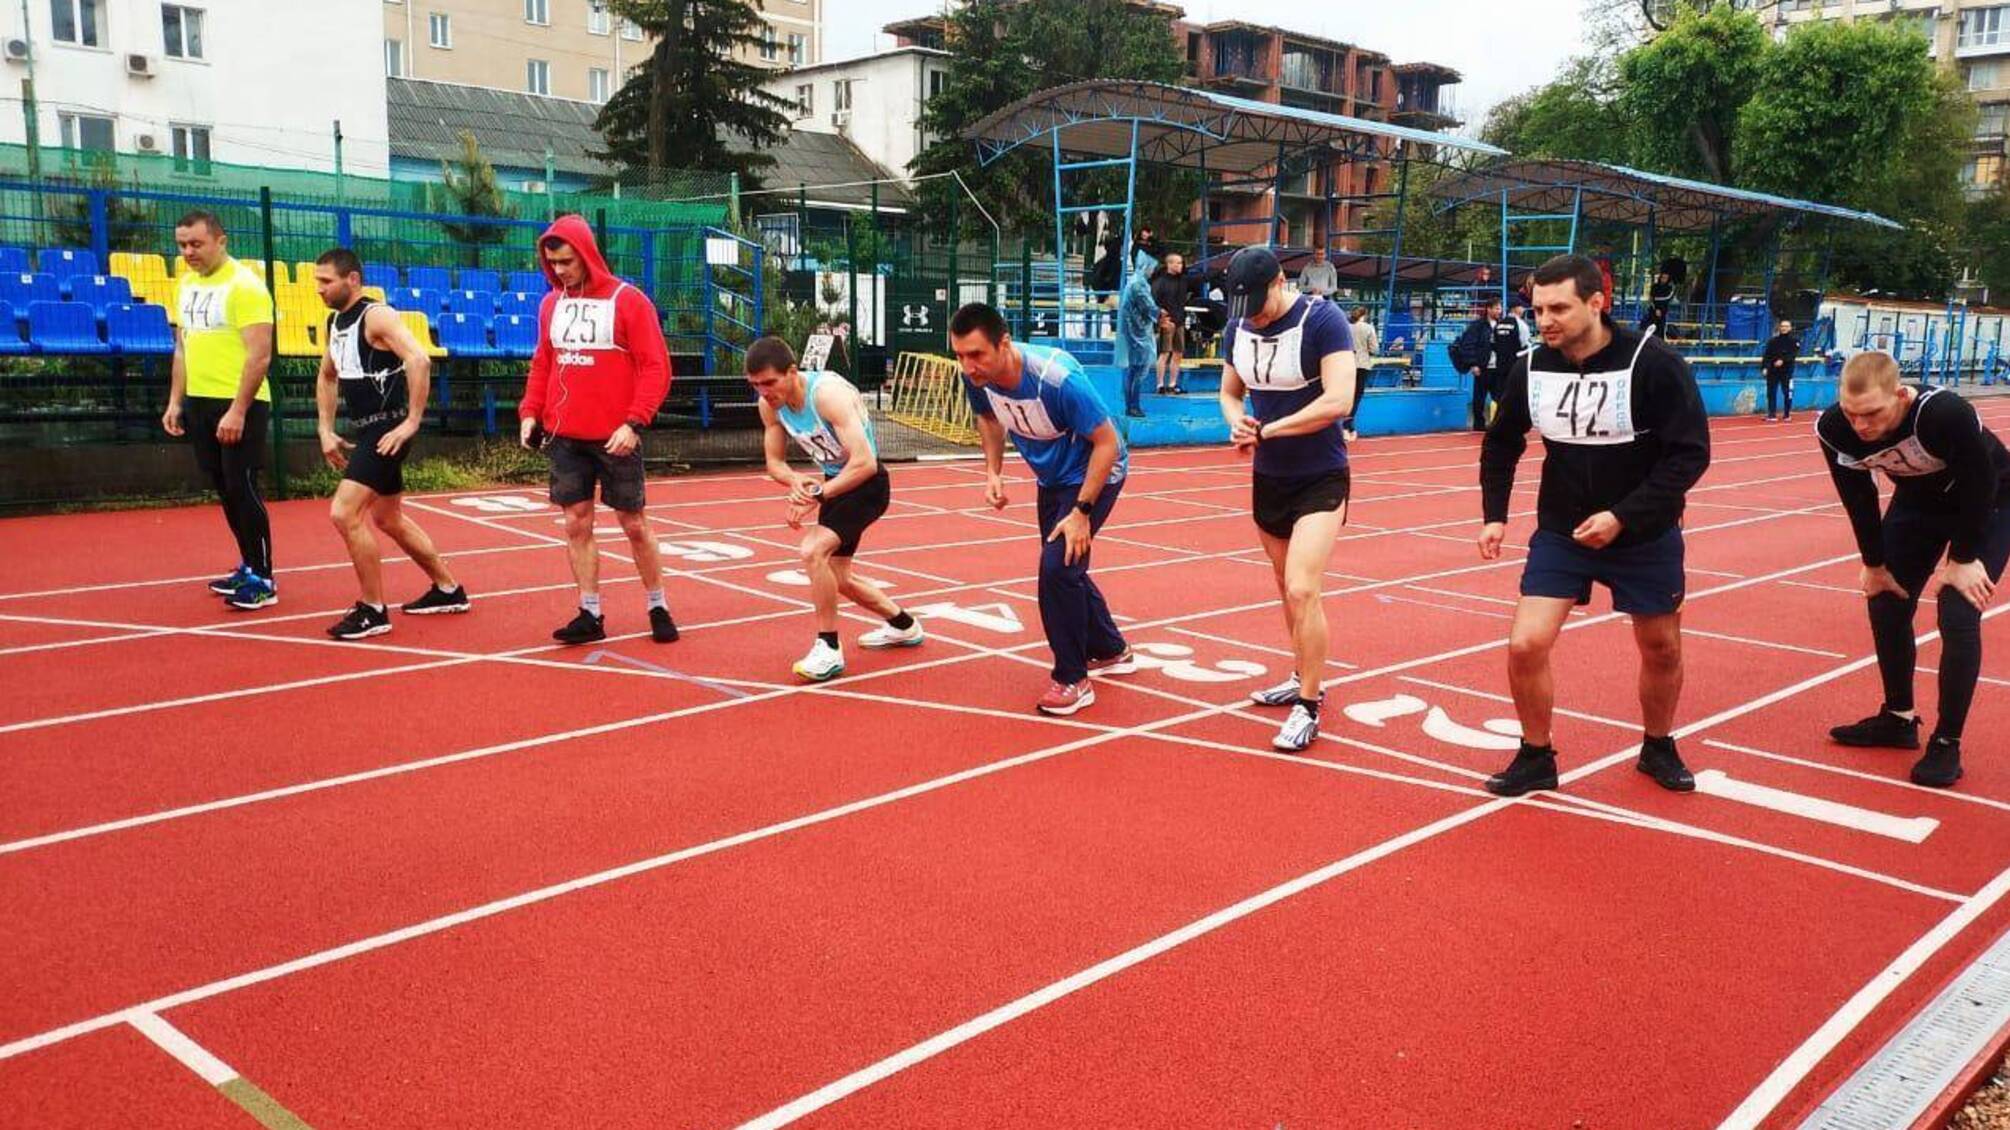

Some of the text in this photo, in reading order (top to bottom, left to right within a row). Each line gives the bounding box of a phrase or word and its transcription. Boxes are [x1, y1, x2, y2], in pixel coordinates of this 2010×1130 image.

[184, 291, 213, 327] 44
[562, 303, 598, 343] 25
[556, 353, 595, 366] adidas
[1251, 338, 1280, 384] 17
[1004, 402, 1036, 436] 11
[1556, 381, 1609, 436] 42
[905, 601, 1025, 633] 4
[1130, 642, 1268, 682] 3
[1342, 693, 1552, 751] 2
[1693, 768, 1941, 844] 1
